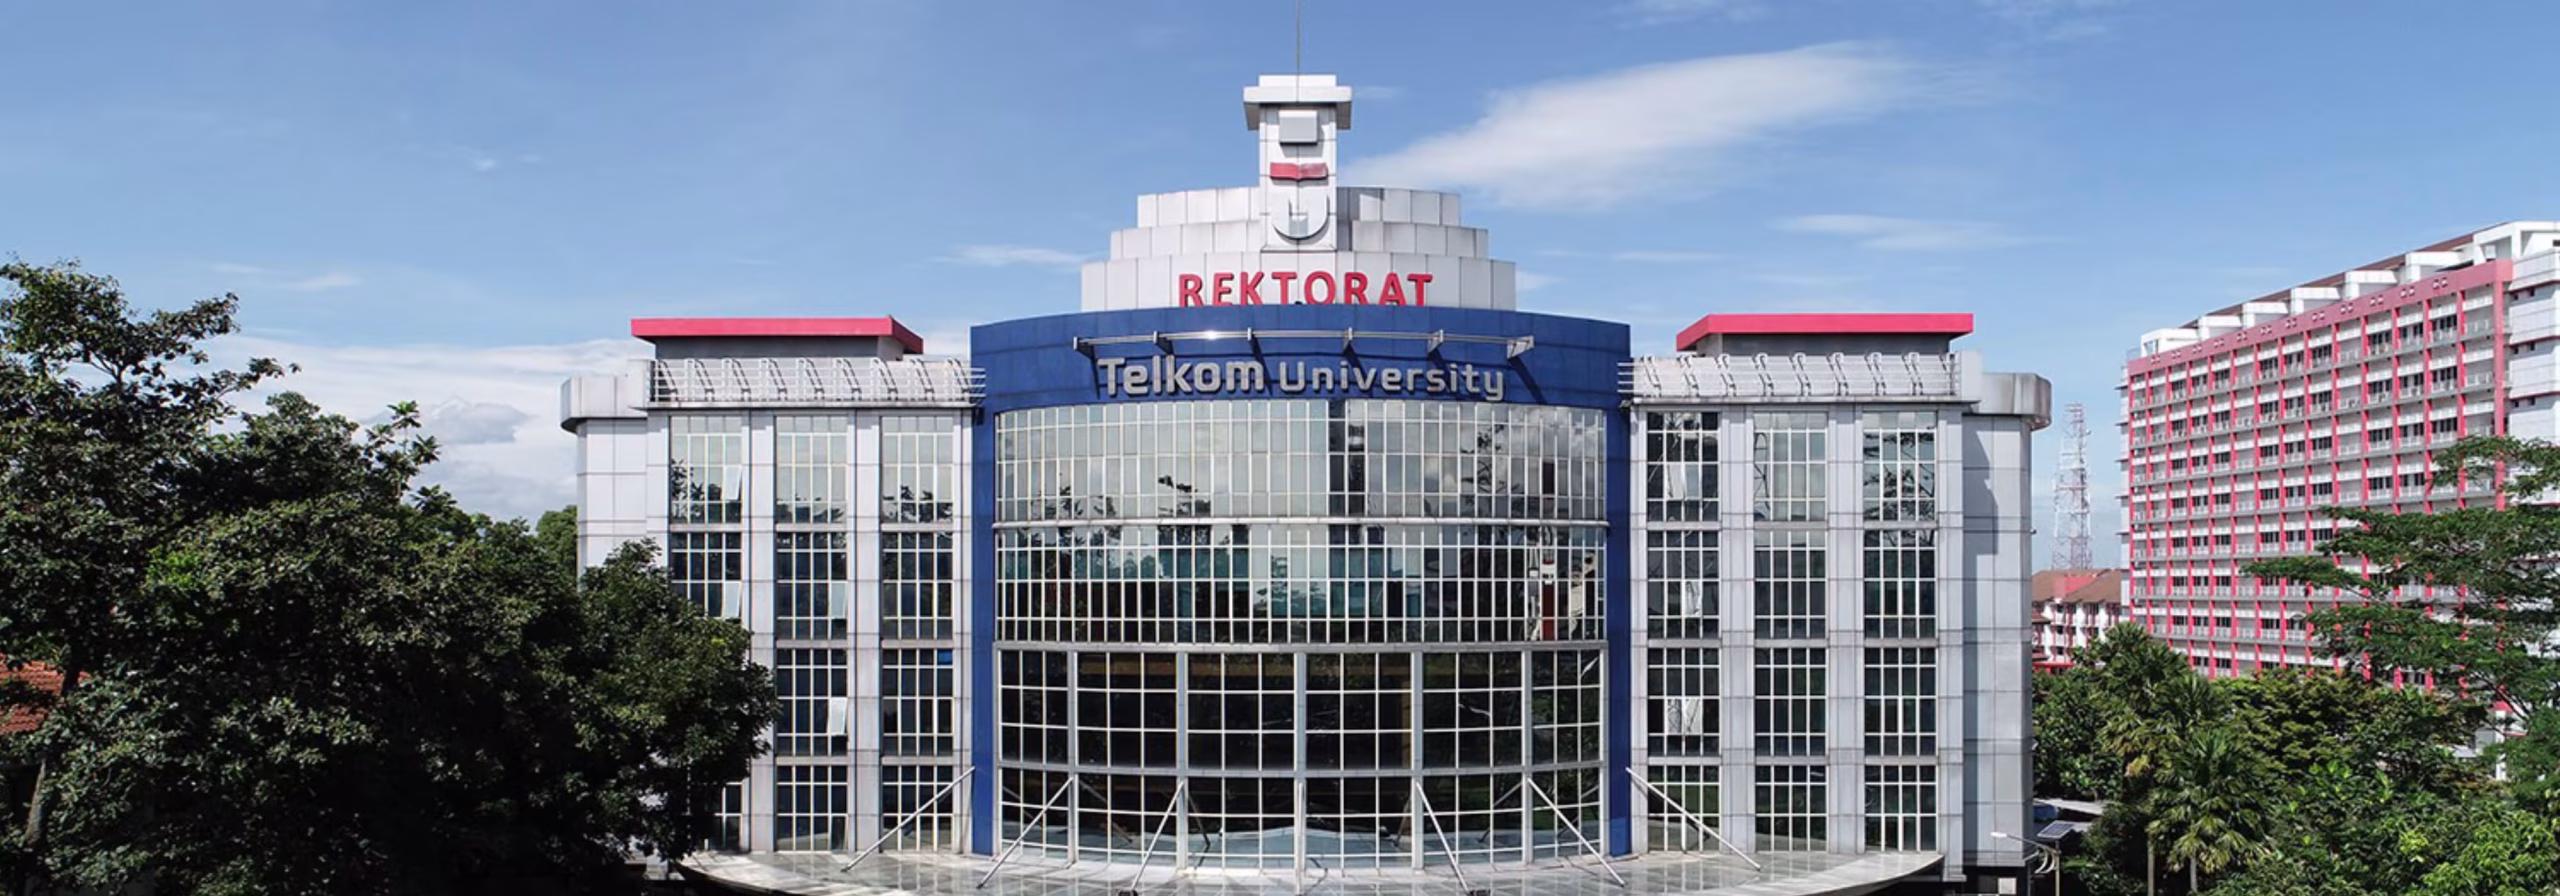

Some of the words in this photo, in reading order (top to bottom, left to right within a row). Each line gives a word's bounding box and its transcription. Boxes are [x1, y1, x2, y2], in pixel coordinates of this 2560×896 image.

[1178, 271, 1433, 307] REKTORAT
[1099, 355, 1264, 396] Telkom
[1279, 361, 1504, 400] University
